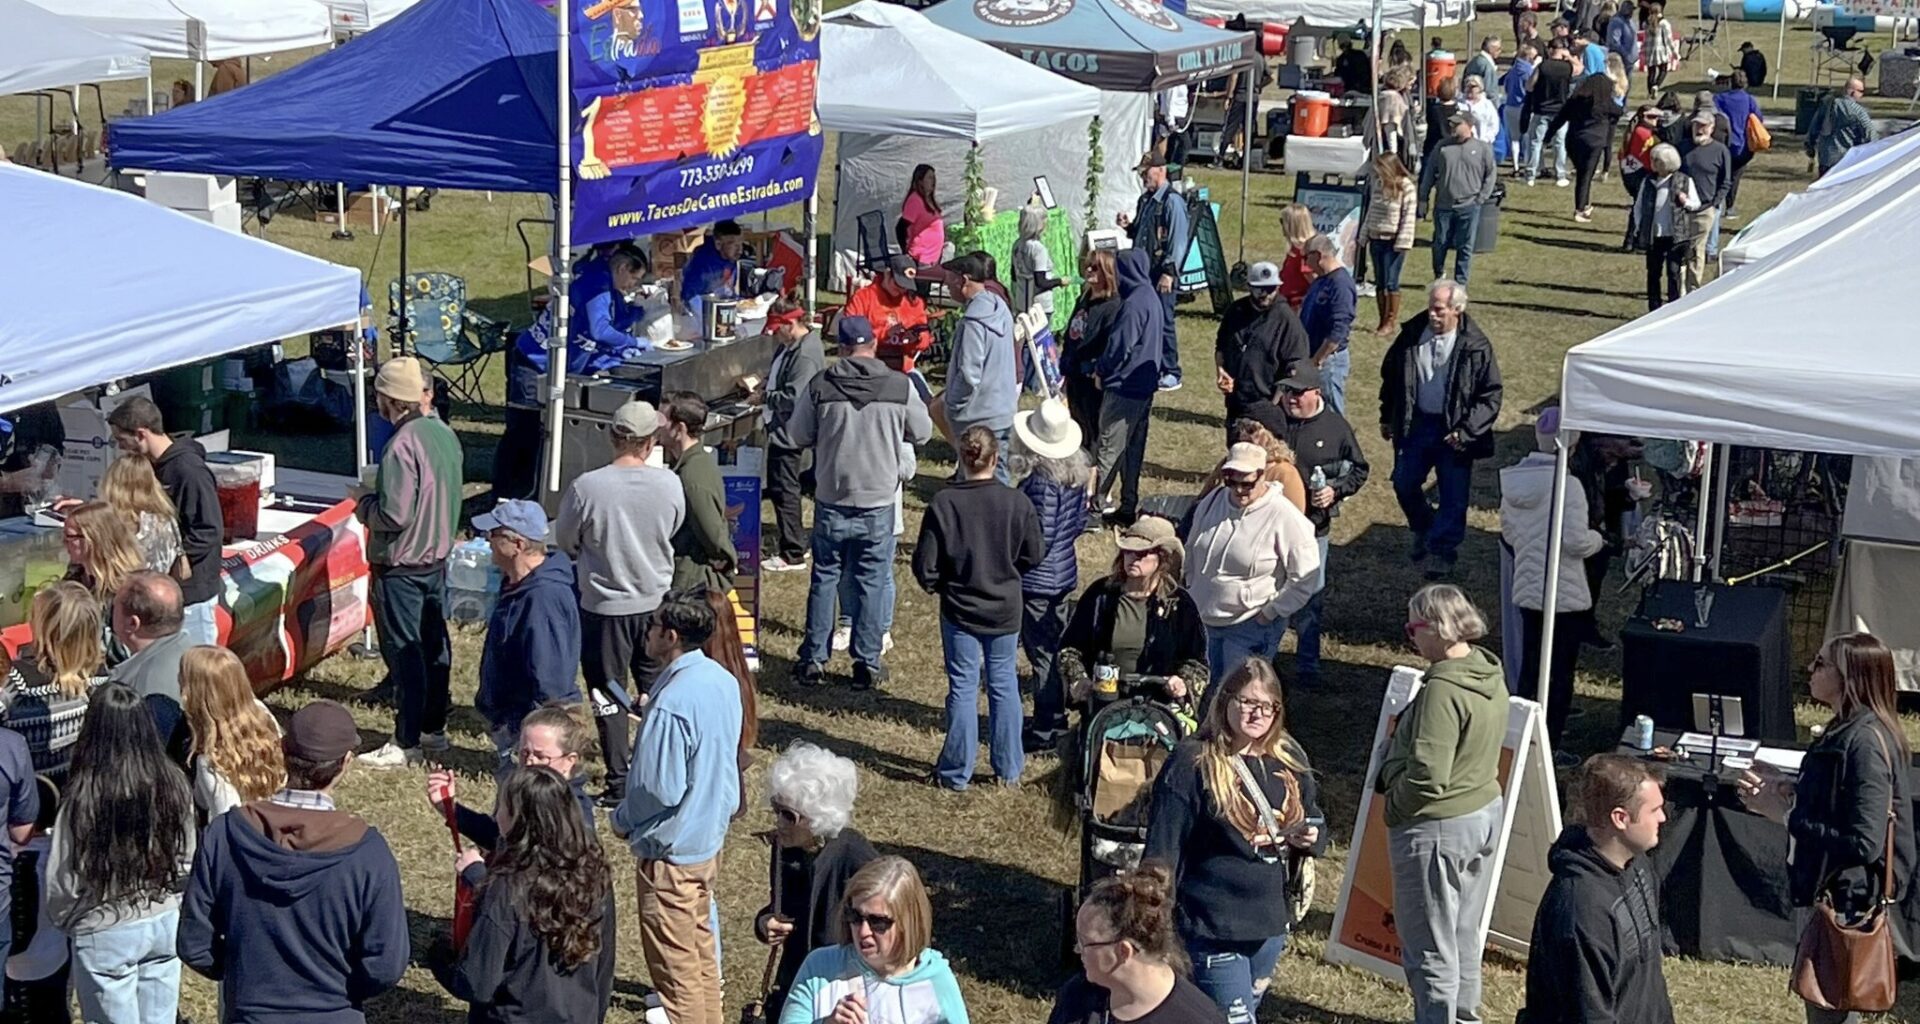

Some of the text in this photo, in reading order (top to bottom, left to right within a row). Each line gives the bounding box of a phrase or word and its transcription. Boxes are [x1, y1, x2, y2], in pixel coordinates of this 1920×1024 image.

[1020, 48, 1099, 73] TACOS
[1217, 42, 1242, 63] TACOS
[607, 176, 804, 228] www.TacosDeCarneEstrada.com
[245, 534, 290, 560] DRINKS
